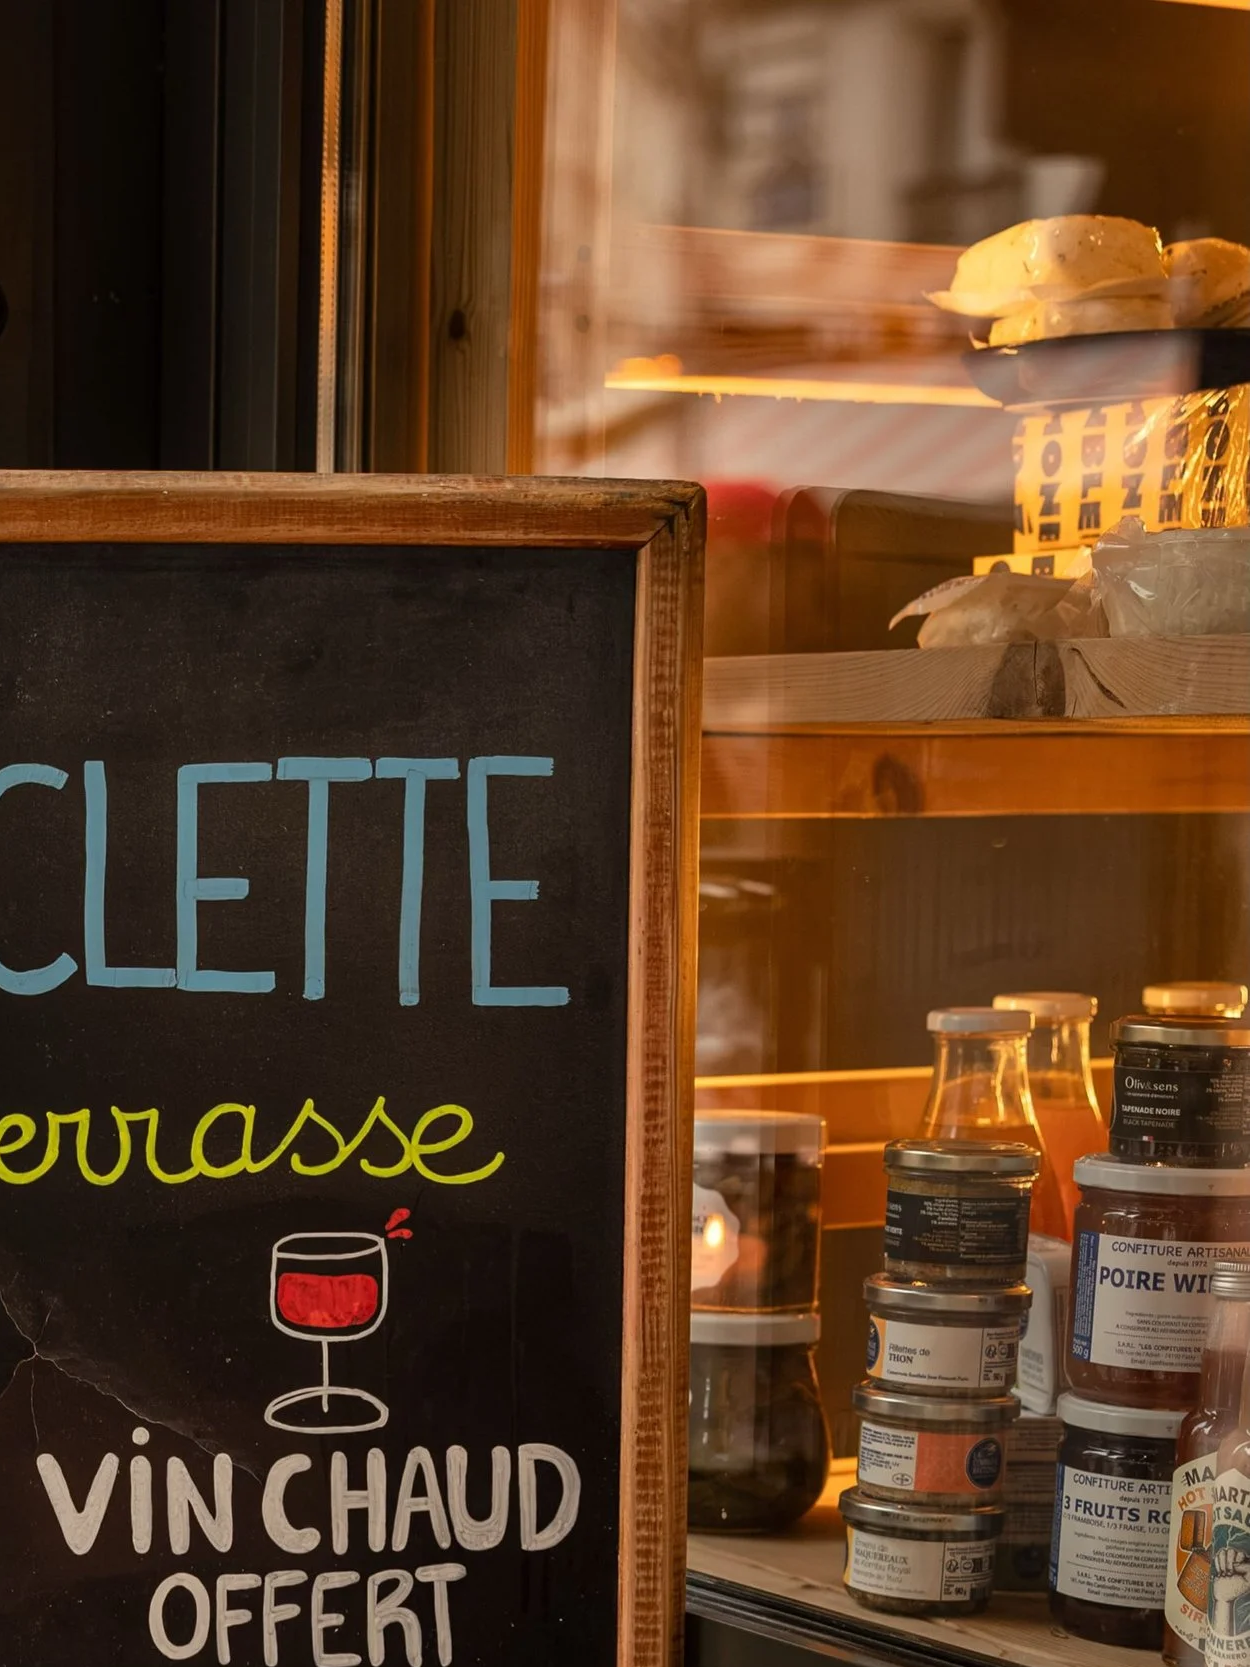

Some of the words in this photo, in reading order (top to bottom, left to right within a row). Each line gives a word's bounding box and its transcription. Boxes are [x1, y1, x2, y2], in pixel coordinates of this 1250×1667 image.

[1122, 1104, 1153, 1115] TAPENADE
[1155, 1108, 1181, 1116] NOIRE
[1111, 1241, 1183, 1257] CONFITURE
[1100, 1266, 1166, 1291] POIRE
[888, 1353, 914, 1365] THON
[1073, 1473, 1134, 1493] CONFITURE
[261, 1443, 581, 1556] CHAUD
[1063, 1495, 1071, 1510] 3
[1075, 1498, 1140, 1522] FRUITS
[1119, 1495, 1140, 1503] depuis
[1178, 1487, 1206, 1512] HOT
